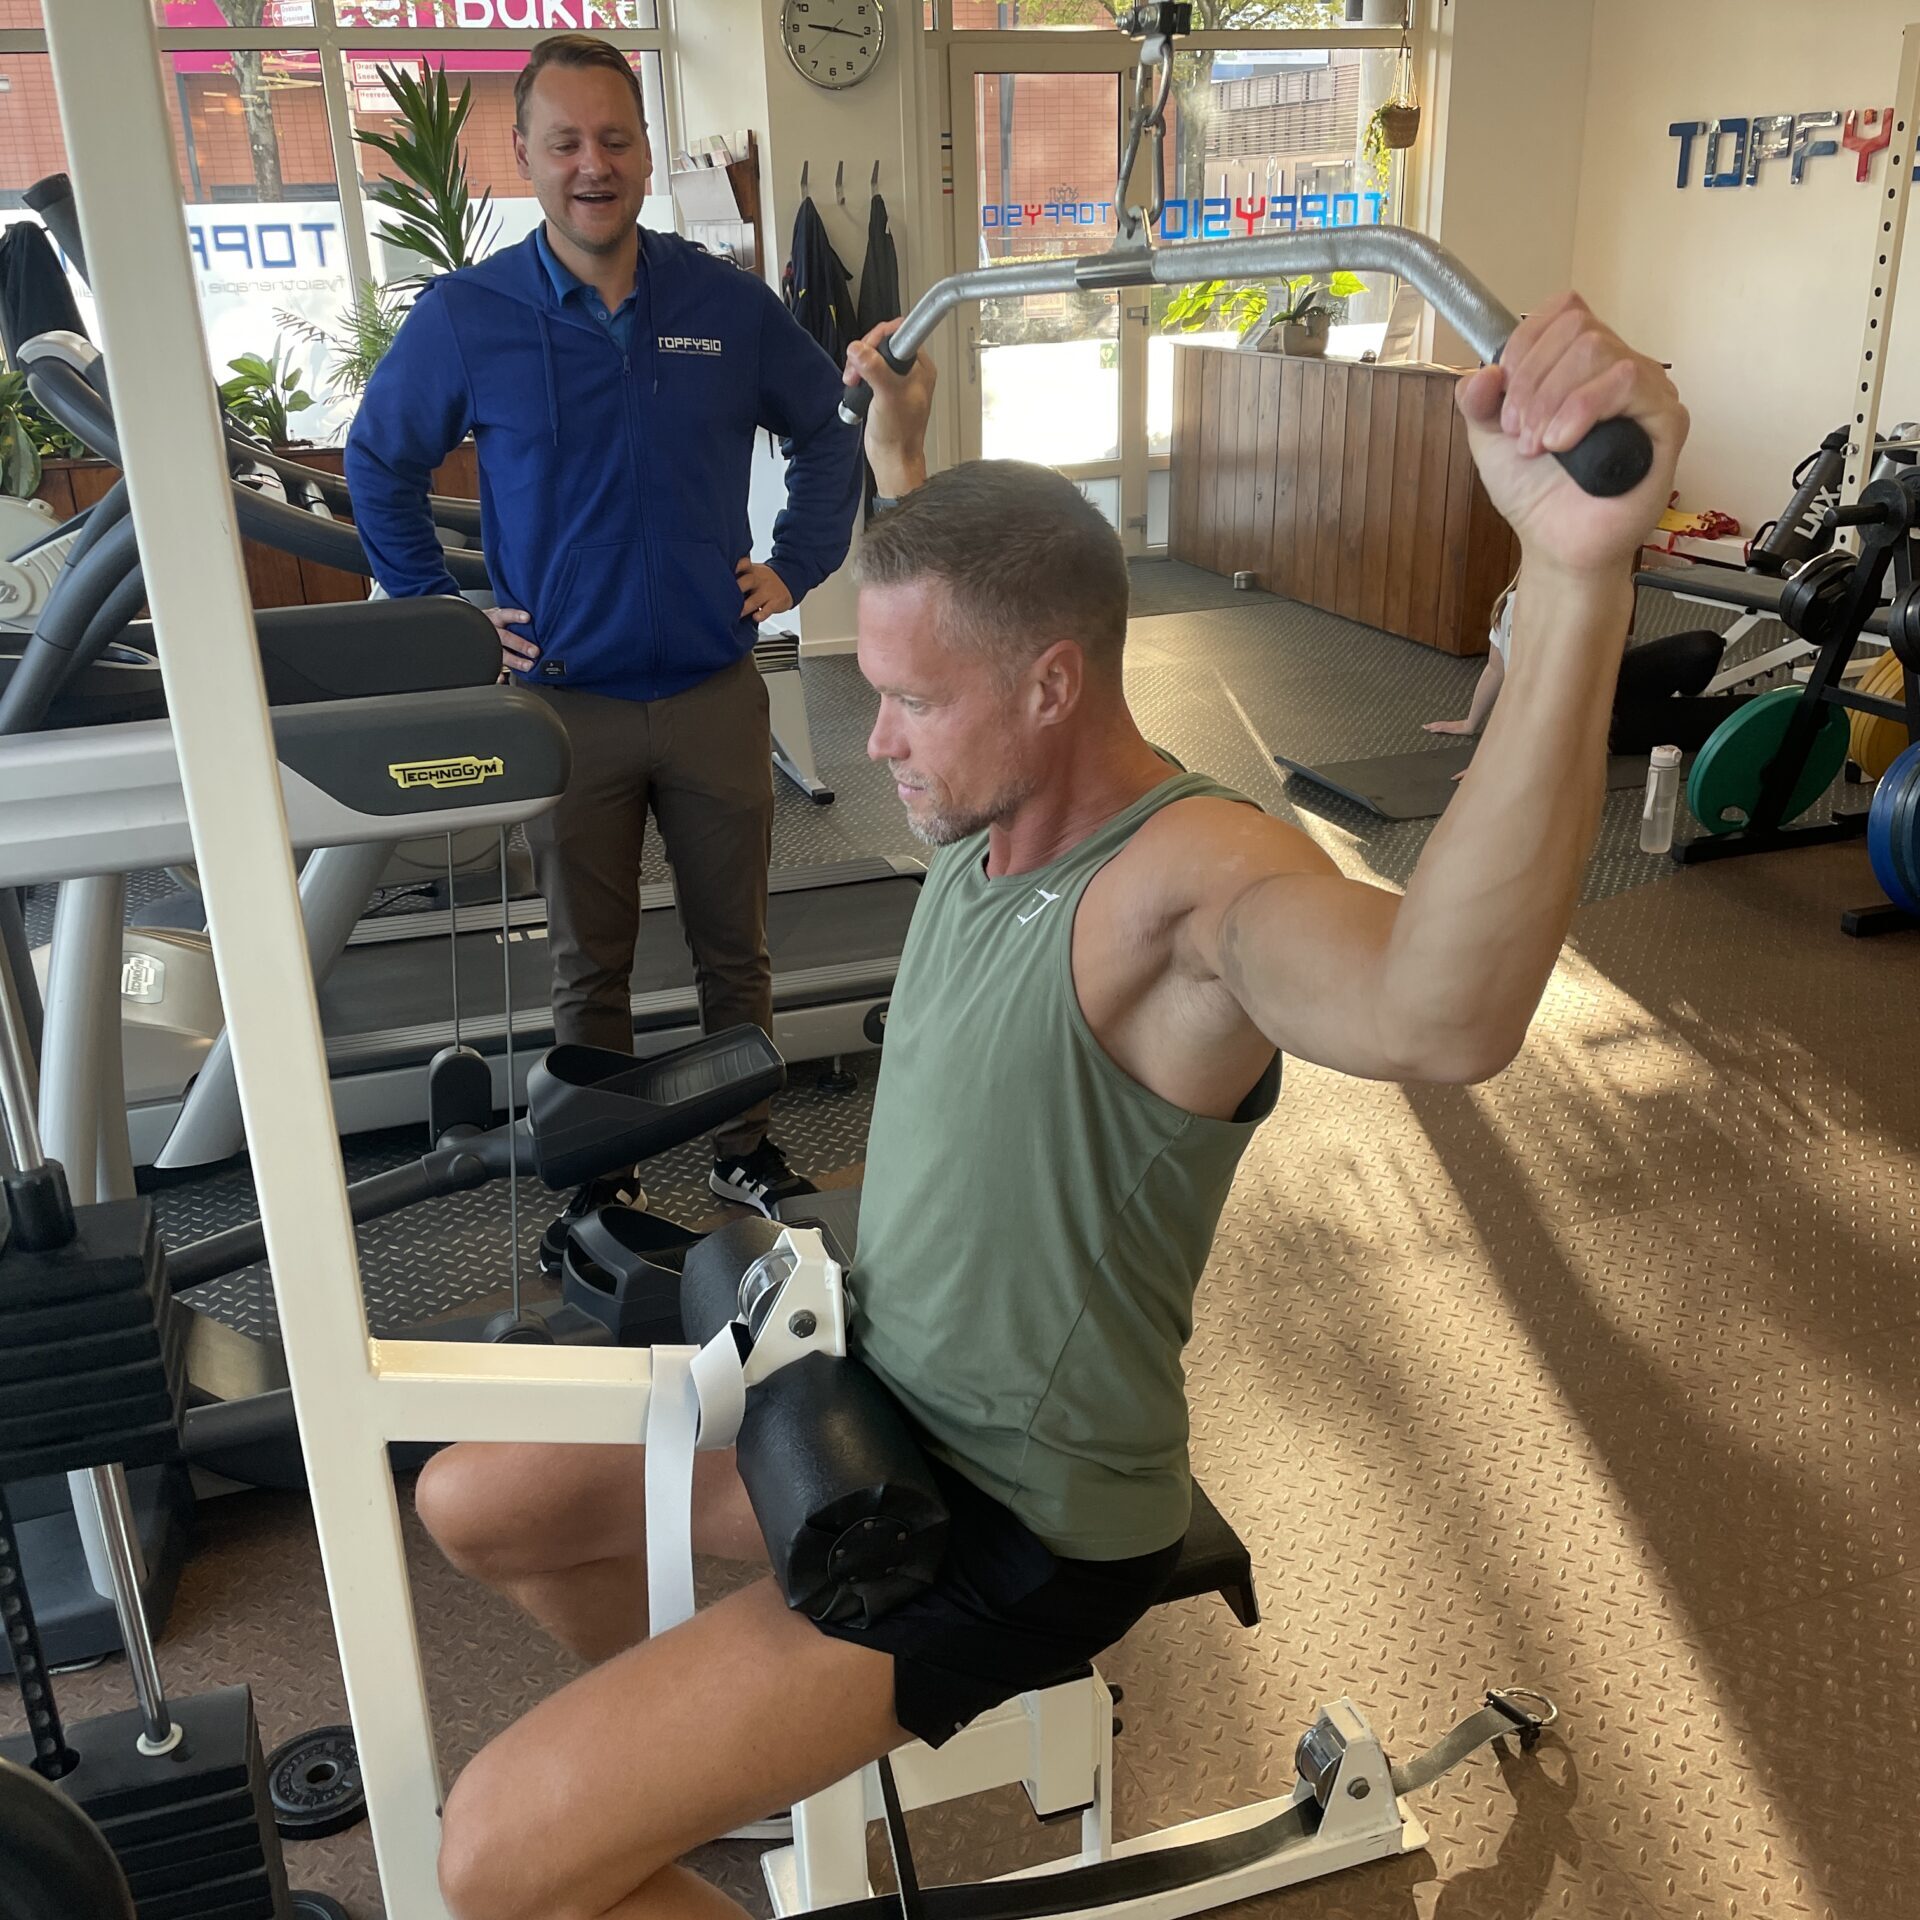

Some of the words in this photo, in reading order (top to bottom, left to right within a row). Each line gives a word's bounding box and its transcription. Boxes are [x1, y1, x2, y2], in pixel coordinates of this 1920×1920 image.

[796, 3, 809, 13] 10
[857, 6, 865, 15] 2
[792, 24, 800, 33] 9
[863, 26, 871, 36] 3
[798, 45, 806, 54] 8
[859, 47, 867, 55] 4
[811, 60, 819, 69] 7
[846, 62, 854, 71] 5
[829, 68, 837, 77] 6
[1669, 107, 1920, 189] TOPFY
[657, 336, 722, 352] TOPFYSIO
